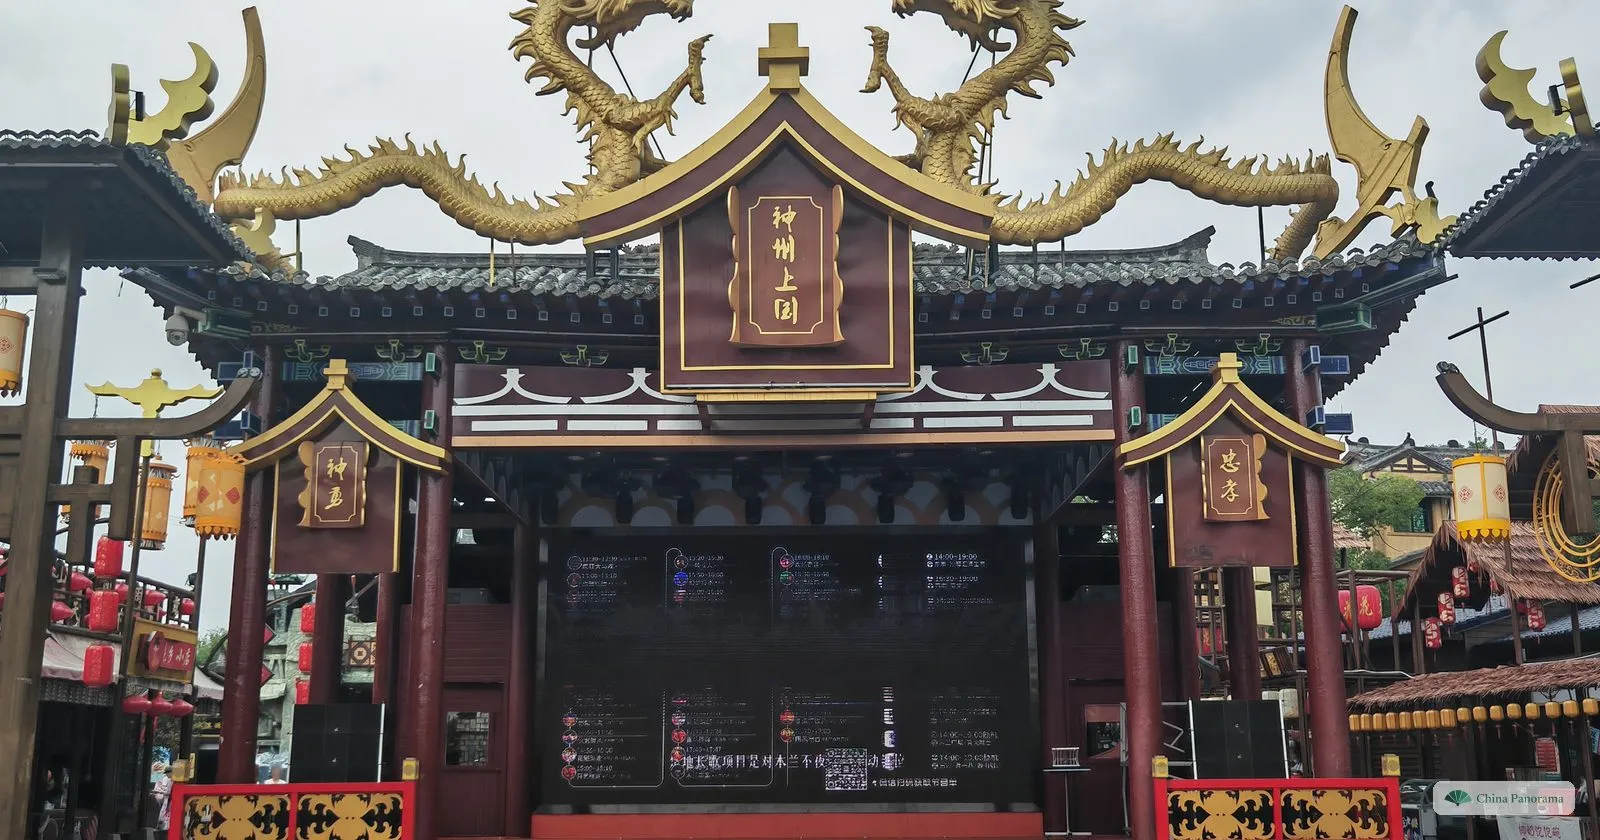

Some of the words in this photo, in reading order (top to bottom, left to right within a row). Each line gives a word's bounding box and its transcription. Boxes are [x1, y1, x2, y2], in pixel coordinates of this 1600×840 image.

[772, 204, 798, 325] 神州上国
[324, 457, 348, 510] 神勇
[1220, 448, 1240, 503] 忠孝
